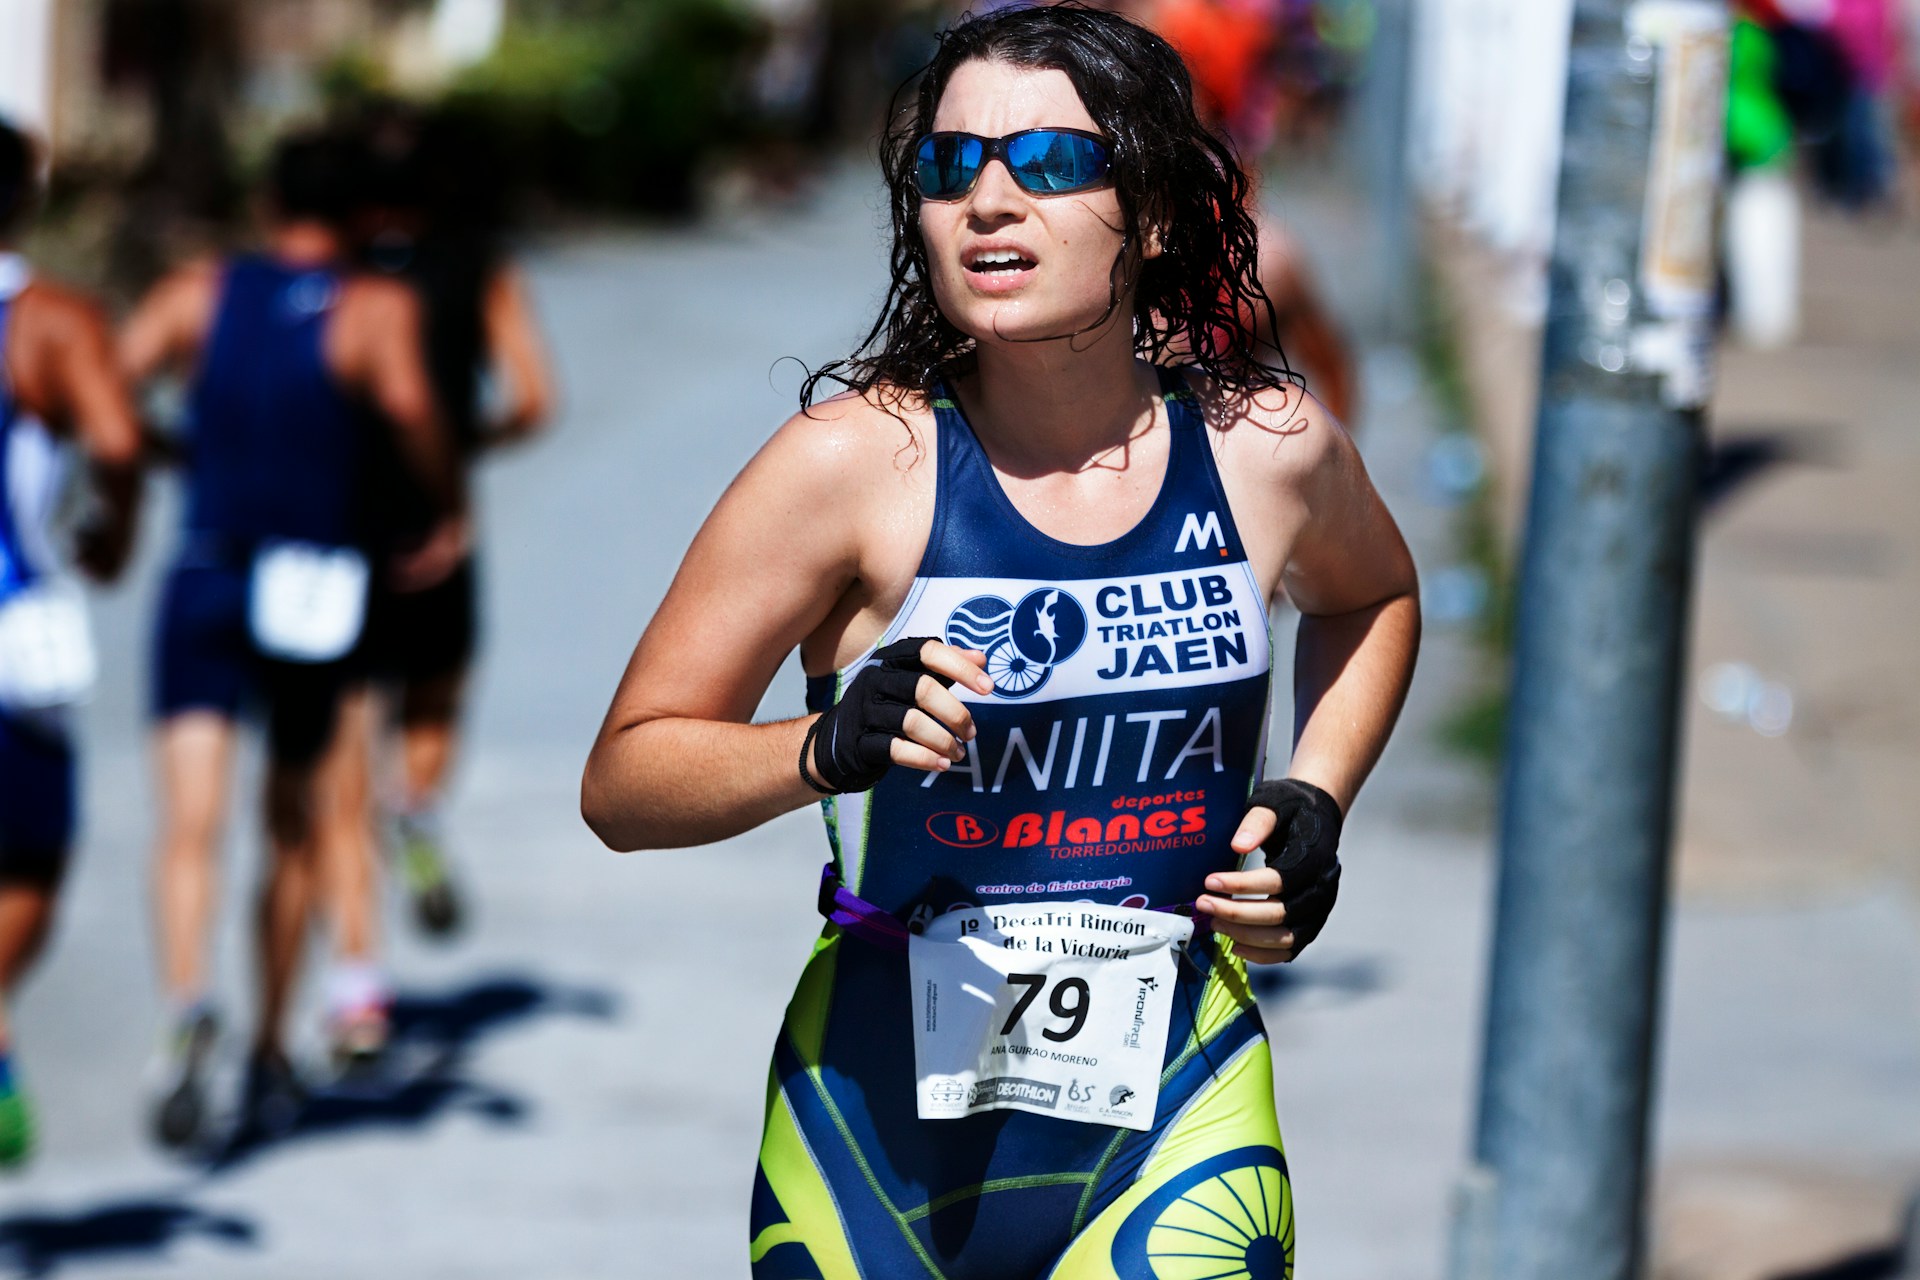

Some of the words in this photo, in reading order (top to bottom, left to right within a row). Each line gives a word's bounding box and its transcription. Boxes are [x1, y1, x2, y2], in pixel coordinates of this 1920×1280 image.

[1096, 575, 1234, 619] CLUB
[1098, 609, 1242, 643] TRIATLON
[1097, 632, 1249, 680] JAEN
[920, 707, 1225, 793] ANIITA
[1112, 788, 1206, 810] deportes
[955, 815, 984, 841] B
[1002, 805, 1207, 849] Blanes
[1049, 833, 1207, 860] TORREDONJIMENO
[976, 884, 1025, 895] centro
[1027, 882, 1044, 894] de
[1048, 876, 1132, 893] fisioterapia
[993, 912, 1072, 930] DecaTri
[1080, 913, 1146, 936] Rincón
[1003, 936, 1027, 950] de
[1035, 936, 1053, 953] la
[1061, 938, 1130, 960] Victoria
[1000, 972, 1091, 1043] 79
[990, 1045, 1007, 1055] ANA
[1008, 1045, 1048, 1058] GUIRAO
[1050, 1052, 1098, 1067] MORENO
[996, 1082, 1056, 1104] DECATHLON
